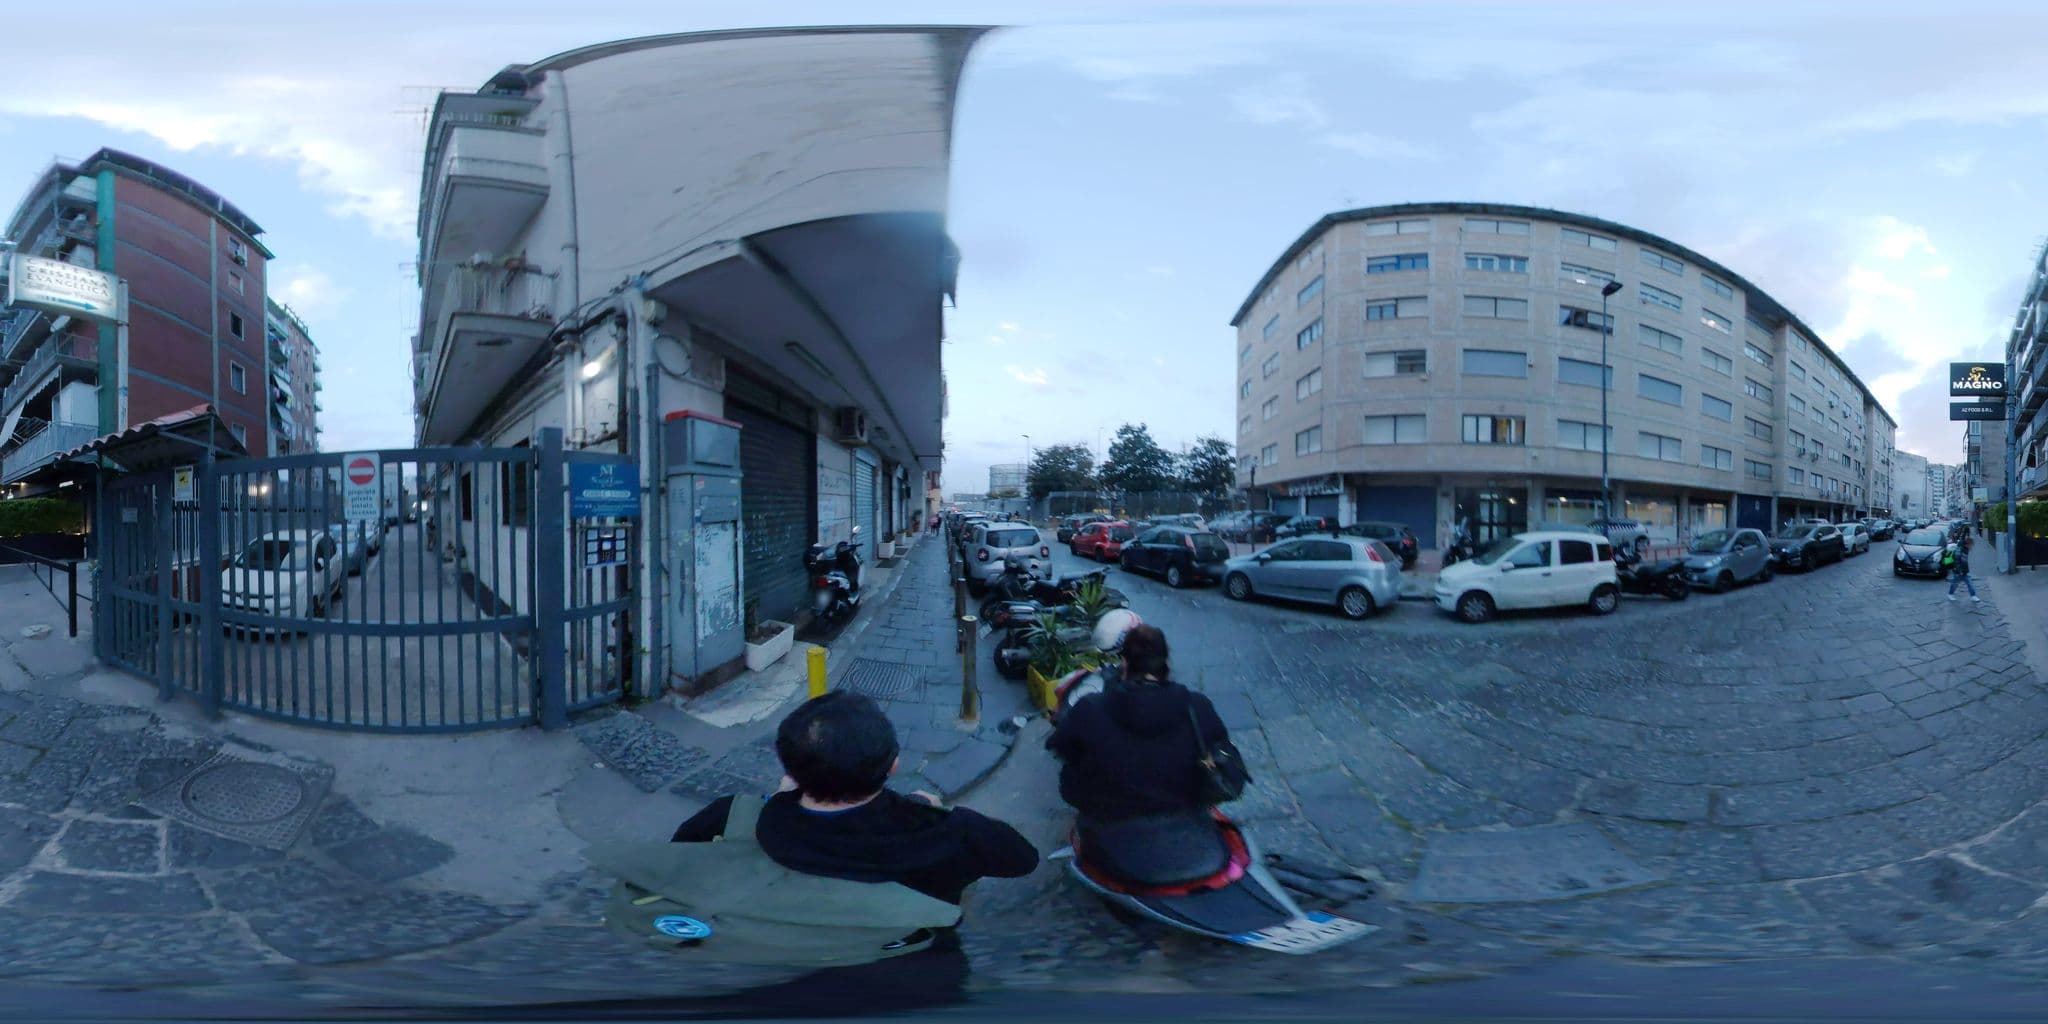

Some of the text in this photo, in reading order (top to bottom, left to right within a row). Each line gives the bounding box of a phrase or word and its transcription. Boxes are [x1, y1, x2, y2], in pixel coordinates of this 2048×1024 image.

[26, 258, 109, 282] CHIESA
[27, 273, 109, 297] EVANGELICA
[1952, 381, 2003, 390] MAGNO
